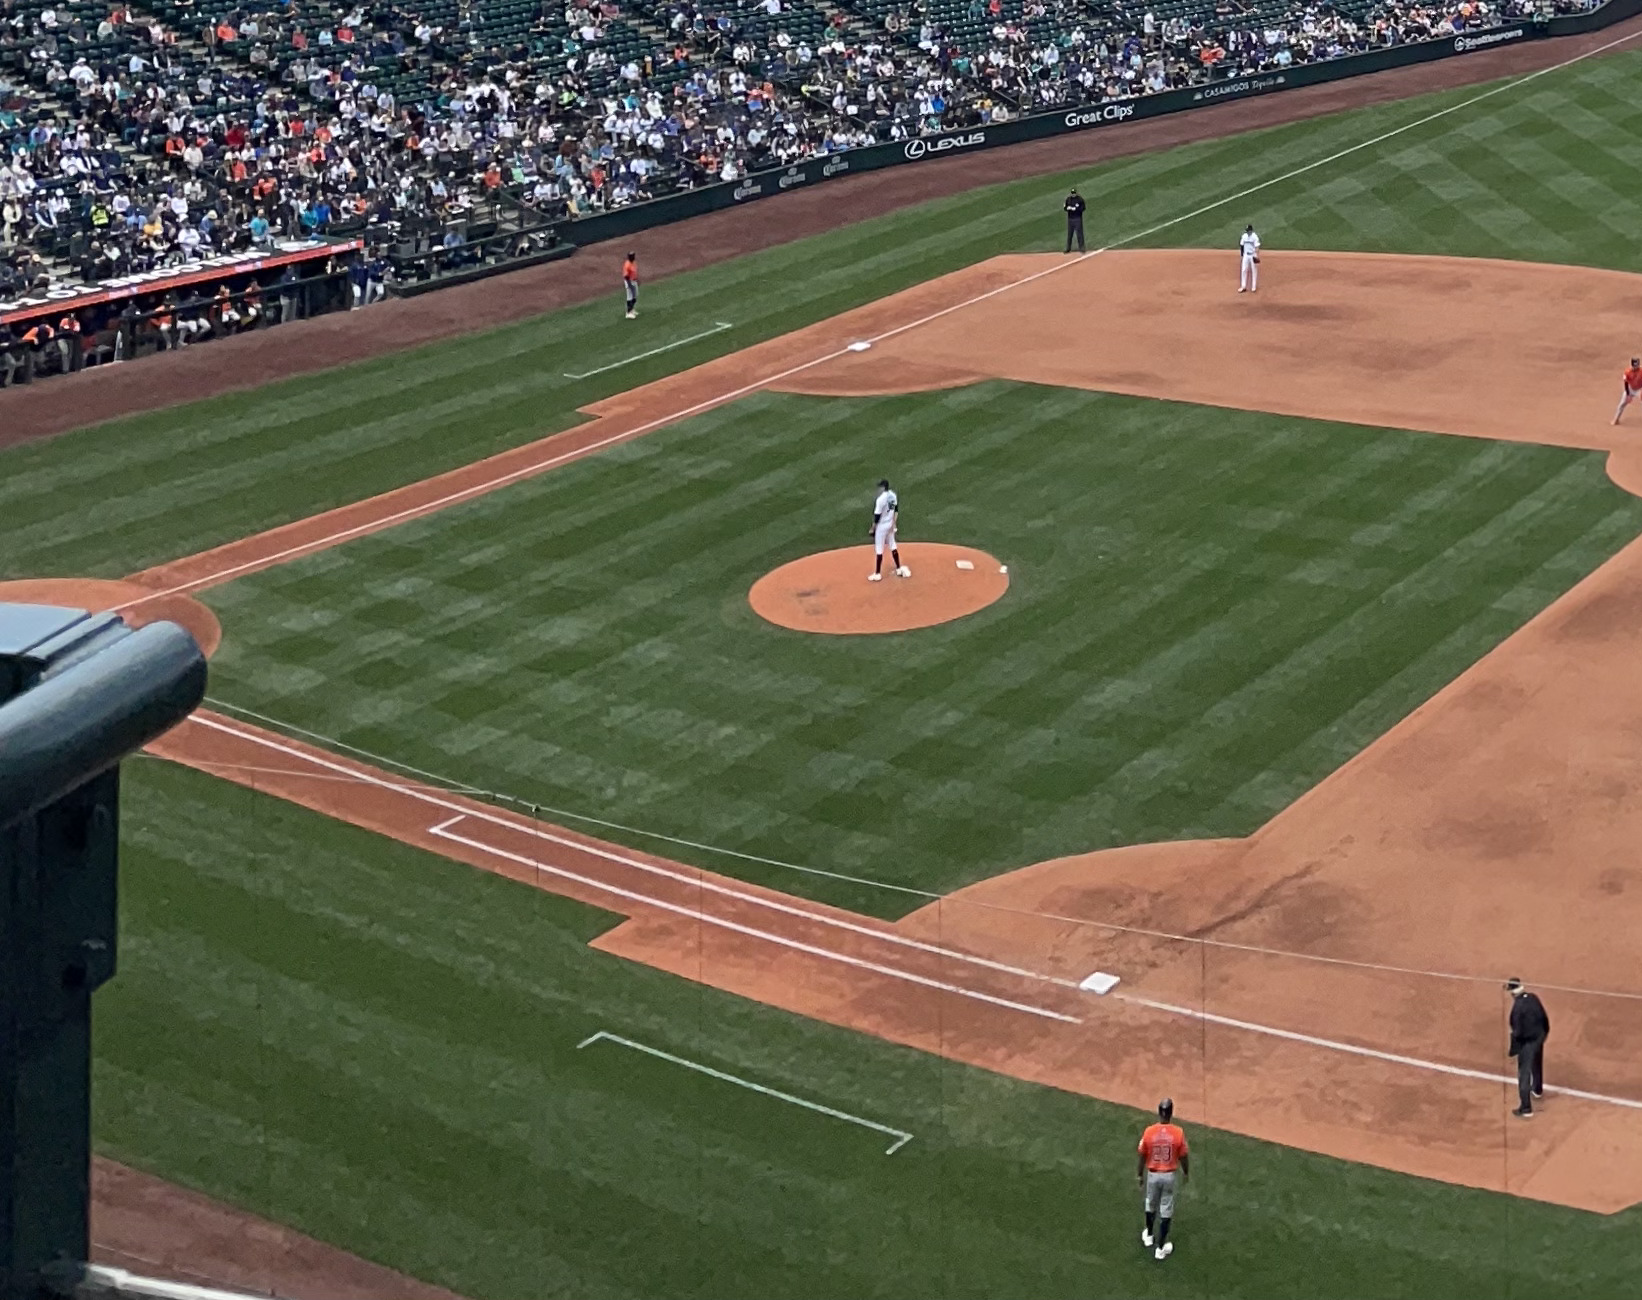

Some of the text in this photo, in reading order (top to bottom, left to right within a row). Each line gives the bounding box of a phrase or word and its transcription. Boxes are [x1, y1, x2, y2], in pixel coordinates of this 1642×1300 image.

[1065, 104, 1131, 127] Great Clips
[927, 133, 985, 152] LEXUS
